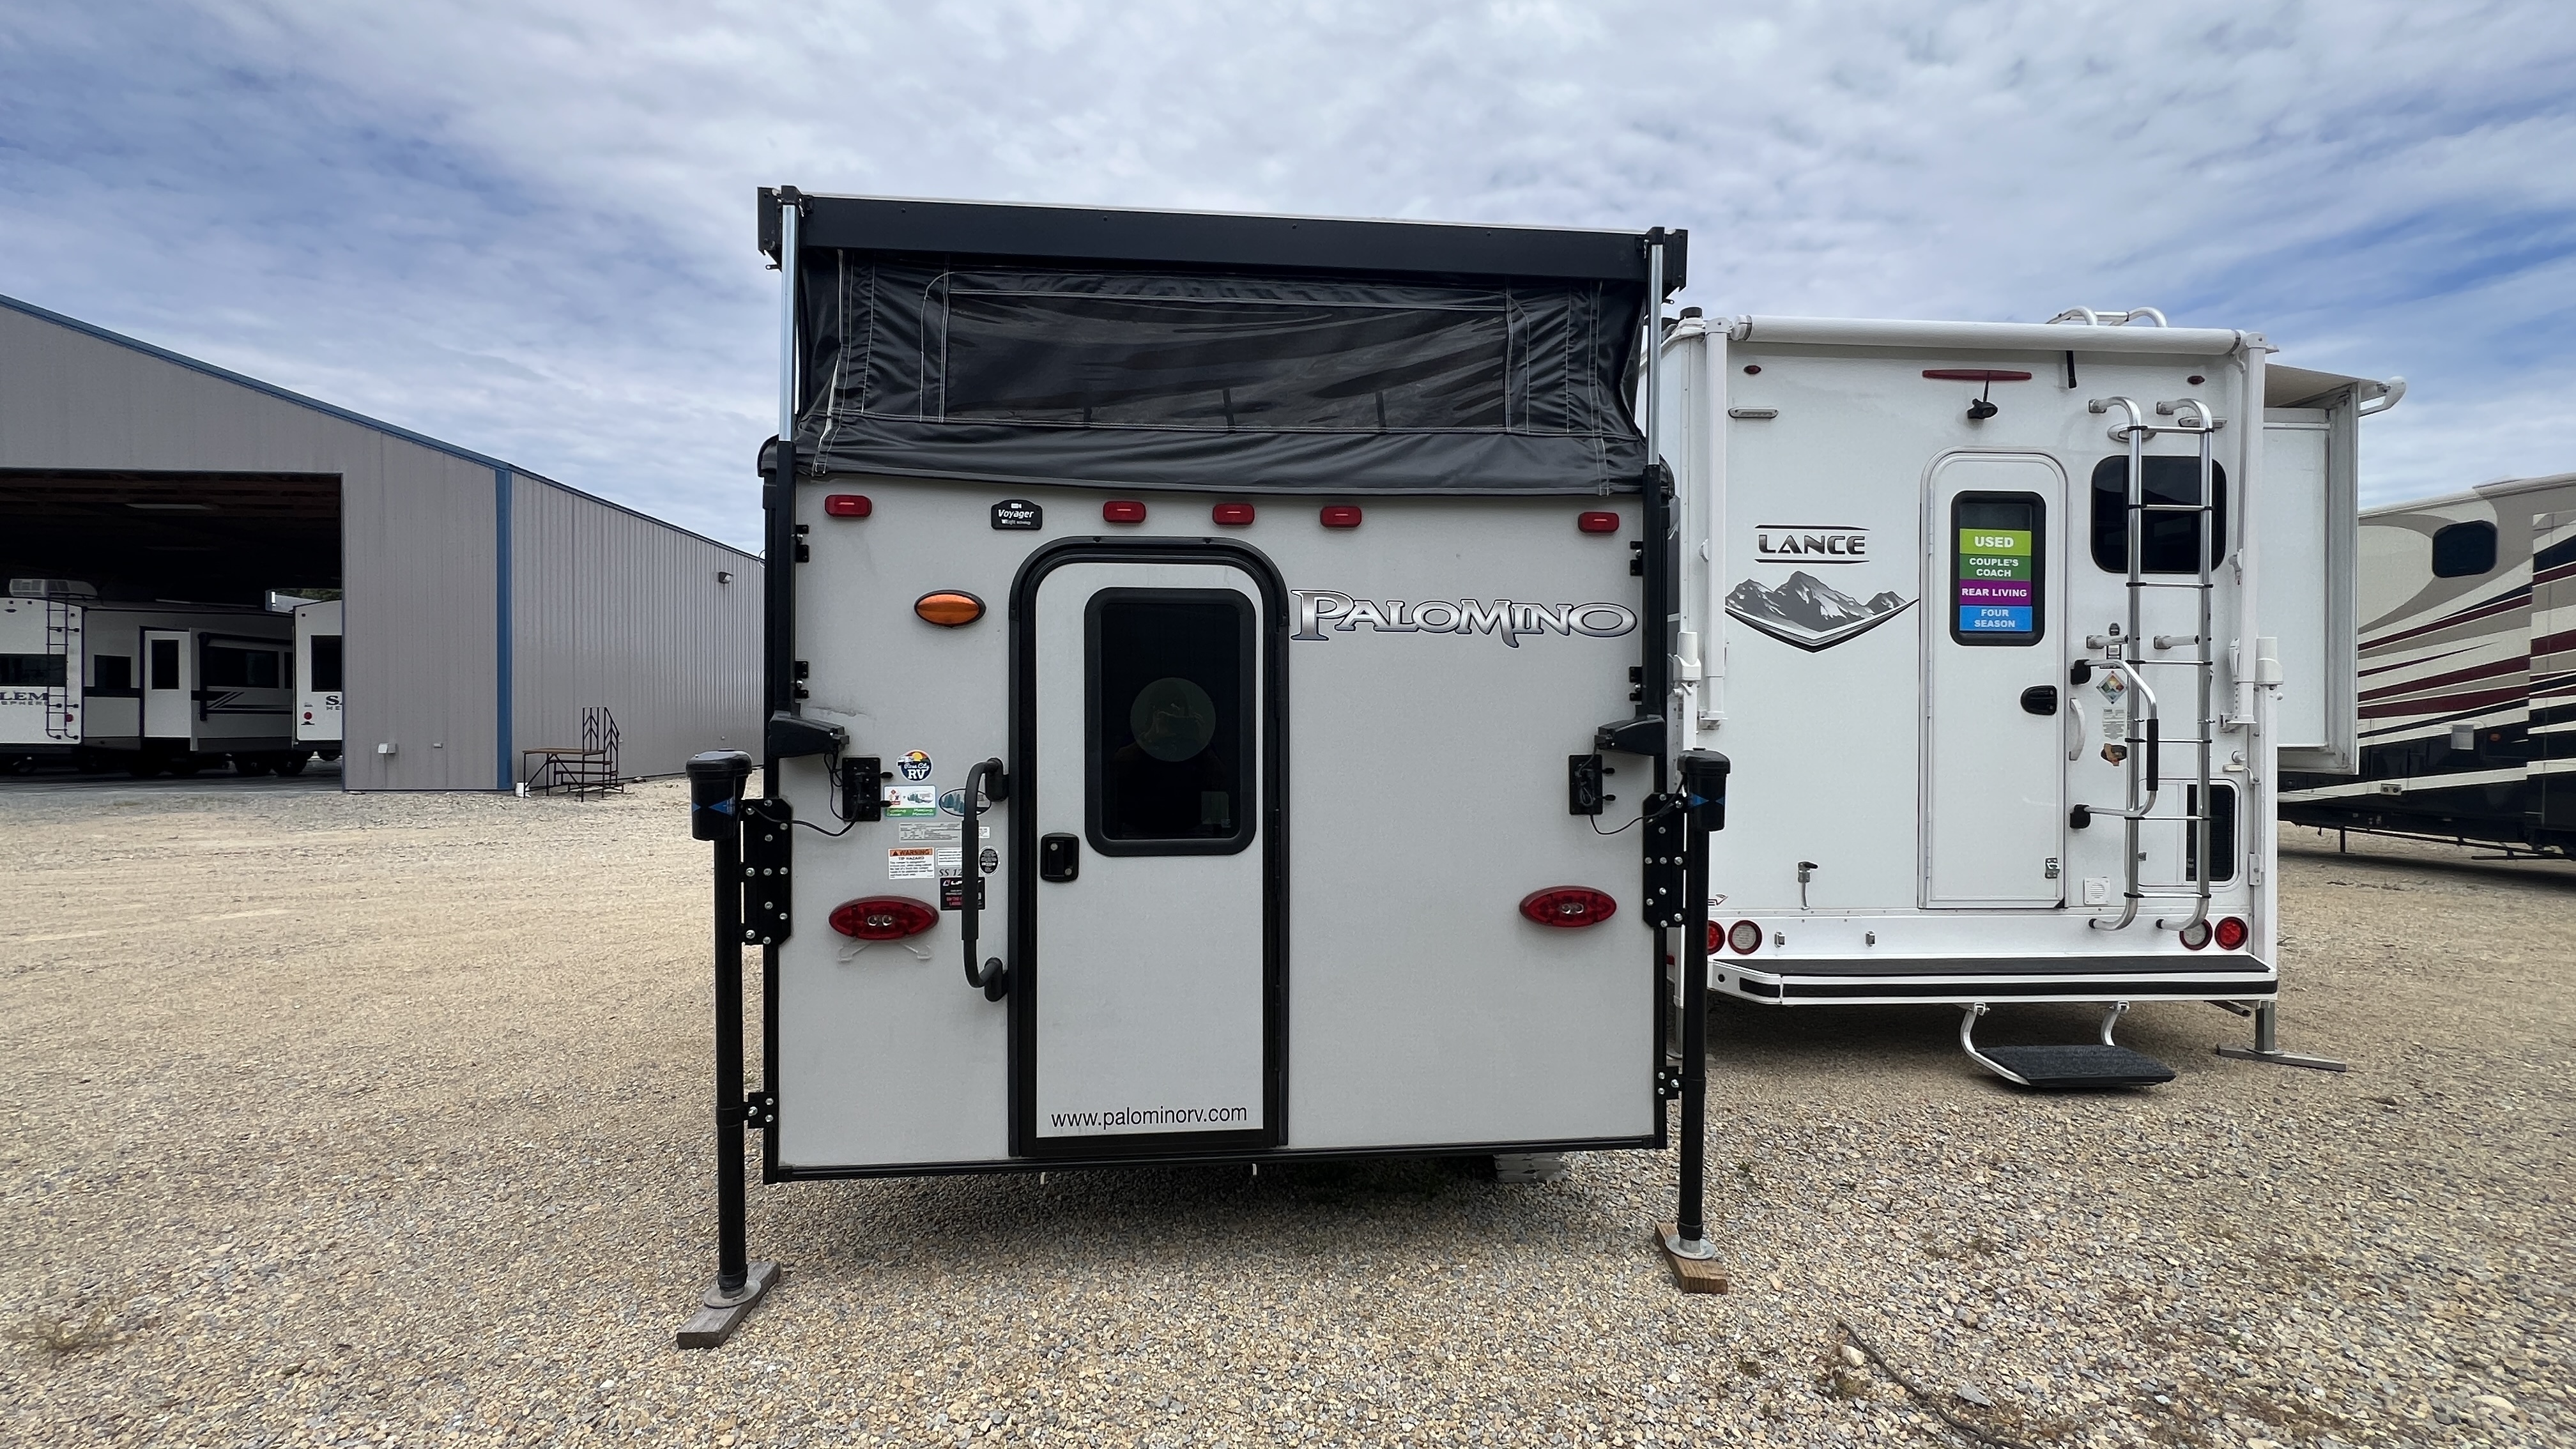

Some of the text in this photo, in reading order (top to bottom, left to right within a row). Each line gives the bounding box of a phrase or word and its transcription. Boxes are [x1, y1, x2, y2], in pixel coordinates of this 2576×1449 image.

[998, 509, 1034, 519] Voyager
[1758, 534, 1866, 555] LANCE
[1974, 536, 2014, 548] USED
[1969, 558, 2019, 567] COUPLE'S
[1976, 569, 2012, 577] COACH
[1961, 588, 2027, 597] REAR LIVING
[907, 769, 926, 779] RV
[939, 868, 949, 877] SS
[1051, 1106, 1247, 1130] www.palominorv.com
